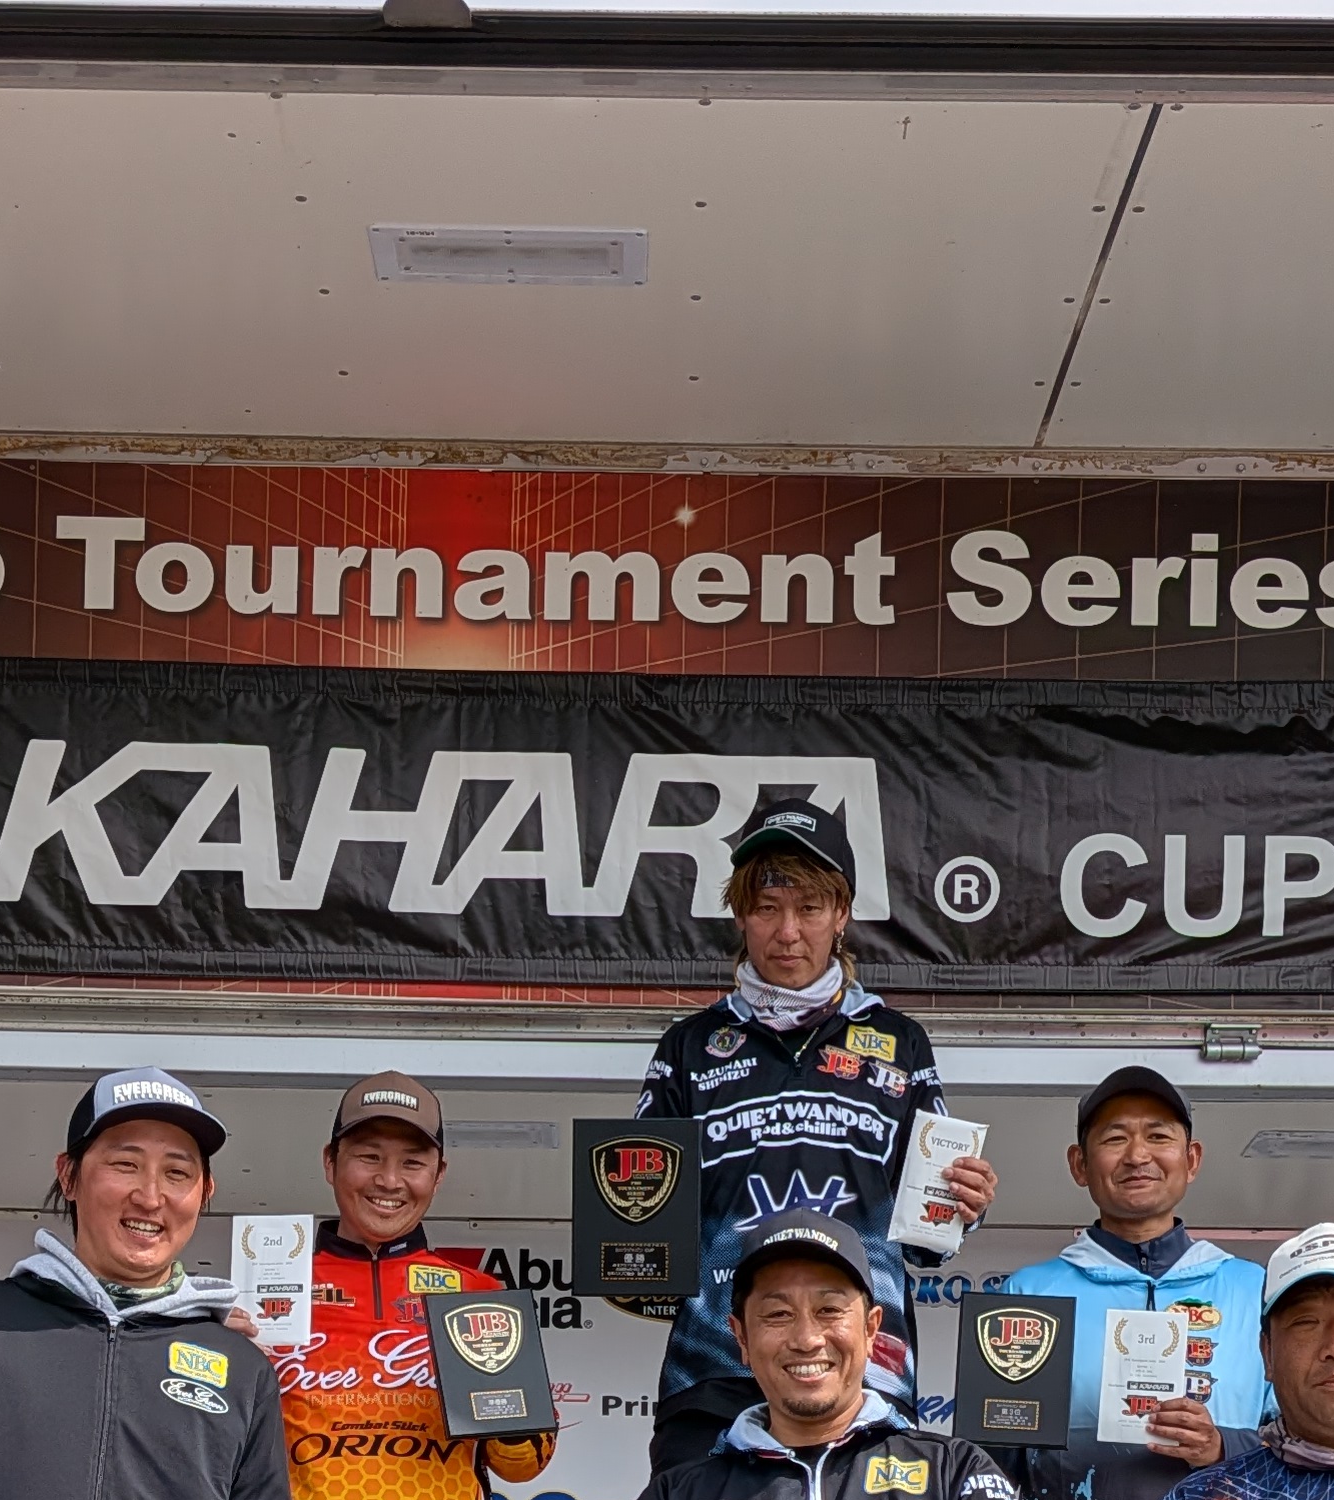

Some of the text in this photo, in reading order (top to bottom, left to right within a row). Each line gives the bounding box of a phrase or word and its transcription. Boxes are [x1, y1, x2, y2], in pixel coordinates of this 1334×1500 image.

[55, 516, 896, 625] Tournament
[691, 1057, 758, 1082] KAZUNARI
[698, 1068, 750, 1091] SHIMIZU
[707, 1101, 885, 1142] QUIET WANDER
[931, 1137, 970, 1152] VICTORY
[608, 1148, 665, 1182] JB
[263, 1236, 282, 1246] 2nd
[795, 1228, 839, 1250] WANDER
[413, 1271, 457, 1289] NBC
[483, 1249, 574, 1291] Abu
[643, 1306, 679, 1316] INTER
[462, 1312, 510, 1341] JB
[991, 1317, 1042, 1346] JB
[1138, 1333, 1155, 1345] 3rd
[176, 1349, 222, 1378] NBC
[331, 1420, 430, 1432] Combat Stick
[291, 1434, 465, 1466] ORION
[874, 1463, 923, 1487] NBC
